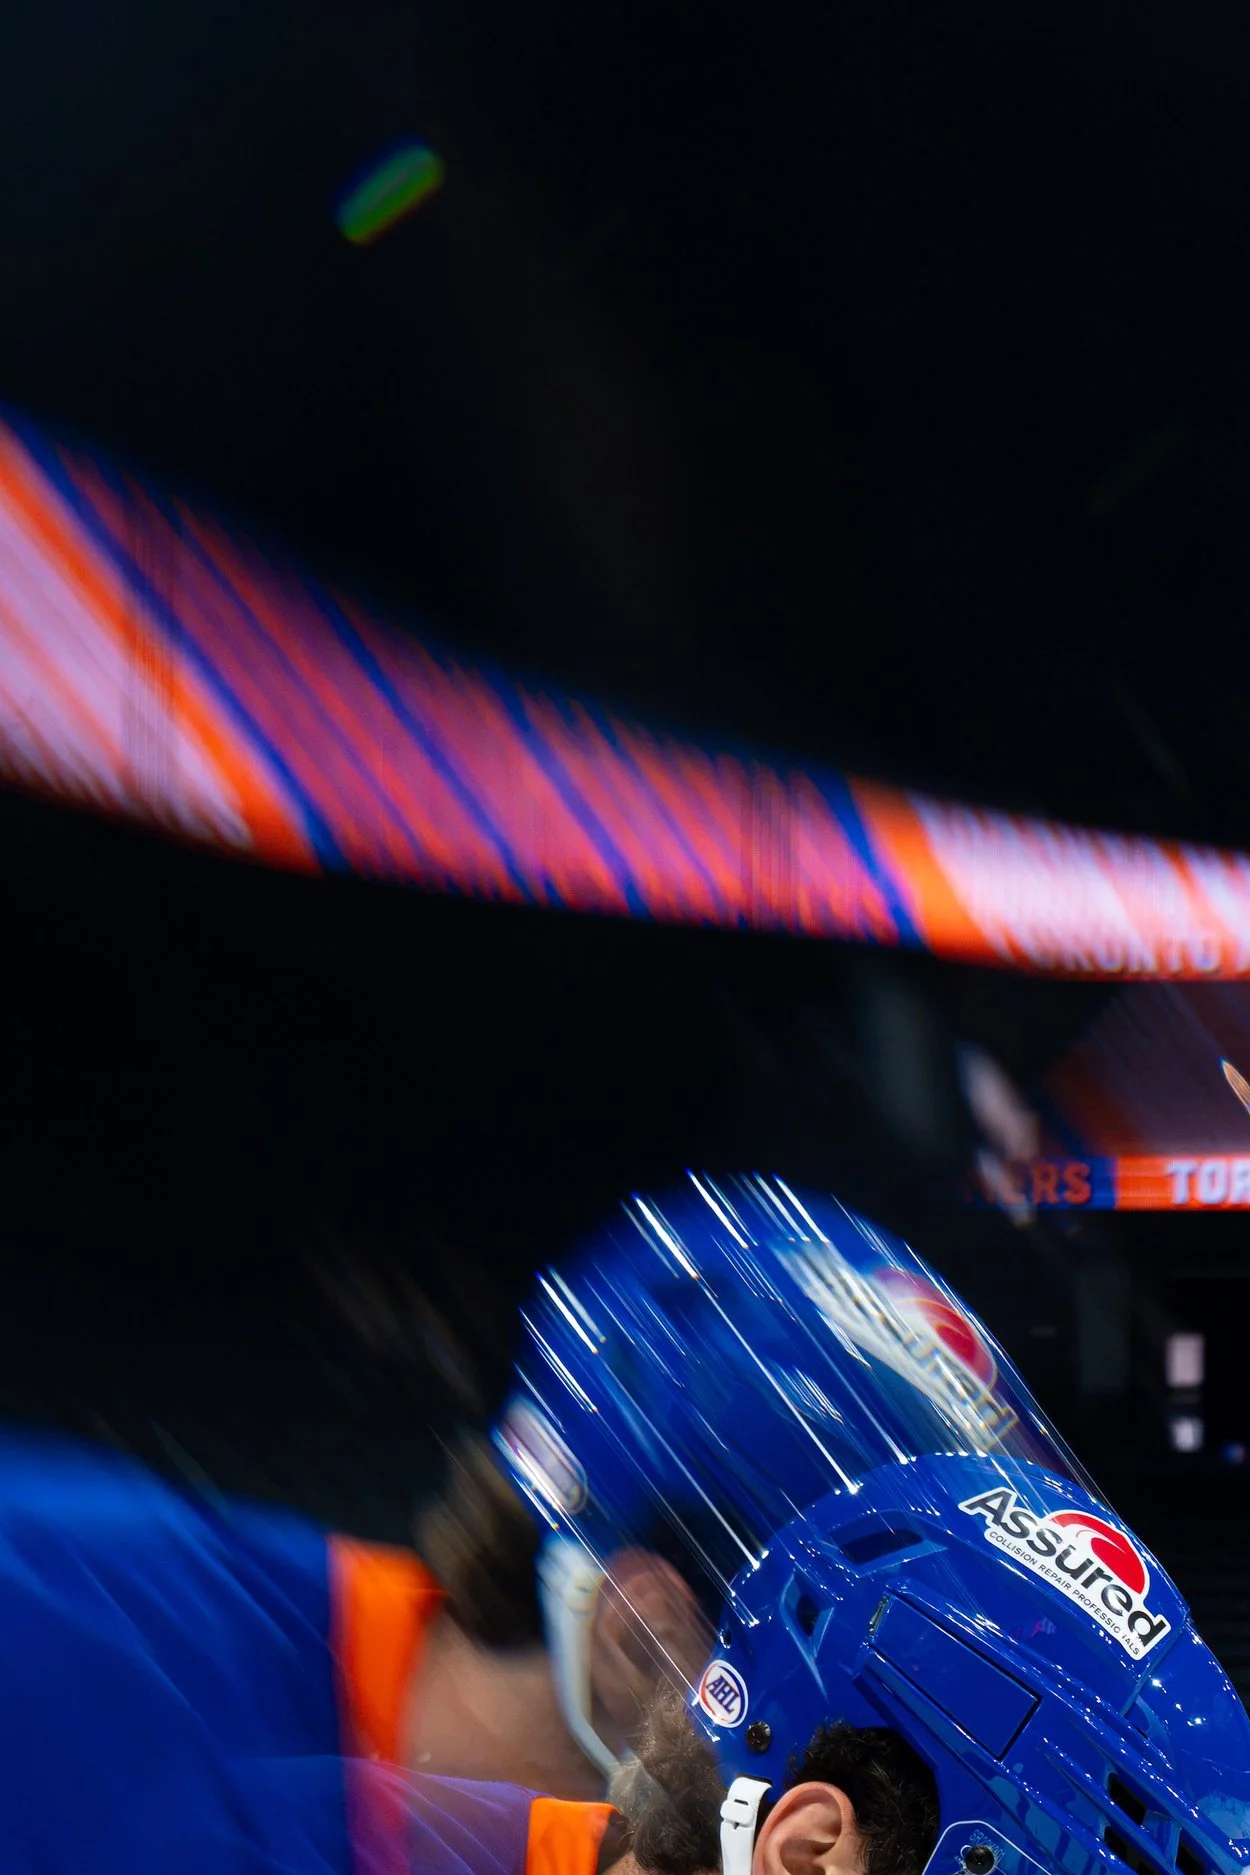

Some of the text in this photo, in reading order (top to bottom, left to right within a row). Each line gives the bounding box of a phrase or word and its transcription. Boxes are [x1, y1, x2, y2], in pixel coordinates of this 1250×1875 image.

[965, 1490, 1167, 1647] Assured
[989, 1531, 1038, 1567] COLLISION
[1038, 1564, 1071, 1591] REPAIR
[706, 1674, 740, 1715] AHL
